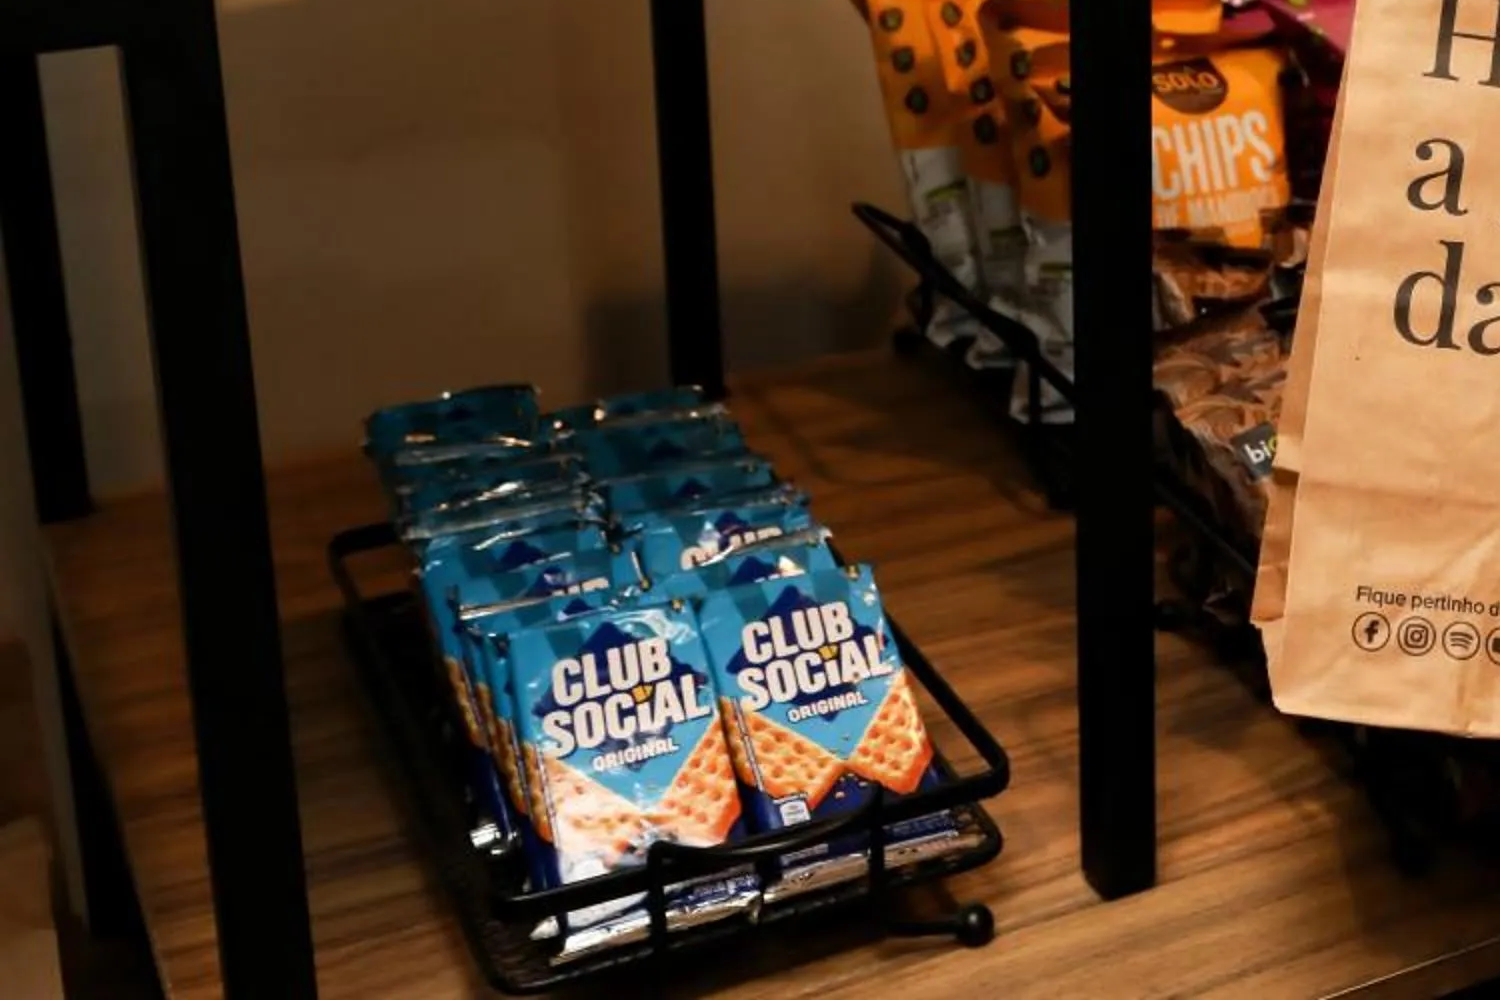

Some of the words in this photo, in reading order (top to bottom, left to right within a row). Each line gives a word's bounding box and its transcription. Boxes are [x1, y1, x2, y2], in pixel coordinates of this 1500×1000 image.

[1151, 109, 1276, 200] CHIPS
[1406, 137, 1469, 217] a
[1356, 586, 1407, 608] Fique
[1410, 593, 1485, 615] pertinho
[741, 602, 855, 665] CLUB
[552, 638, 673, 706] CLUB
[788, 691, 869, 724] ORIGINAL
[592, 737, 680, 772] ORIGINAL
